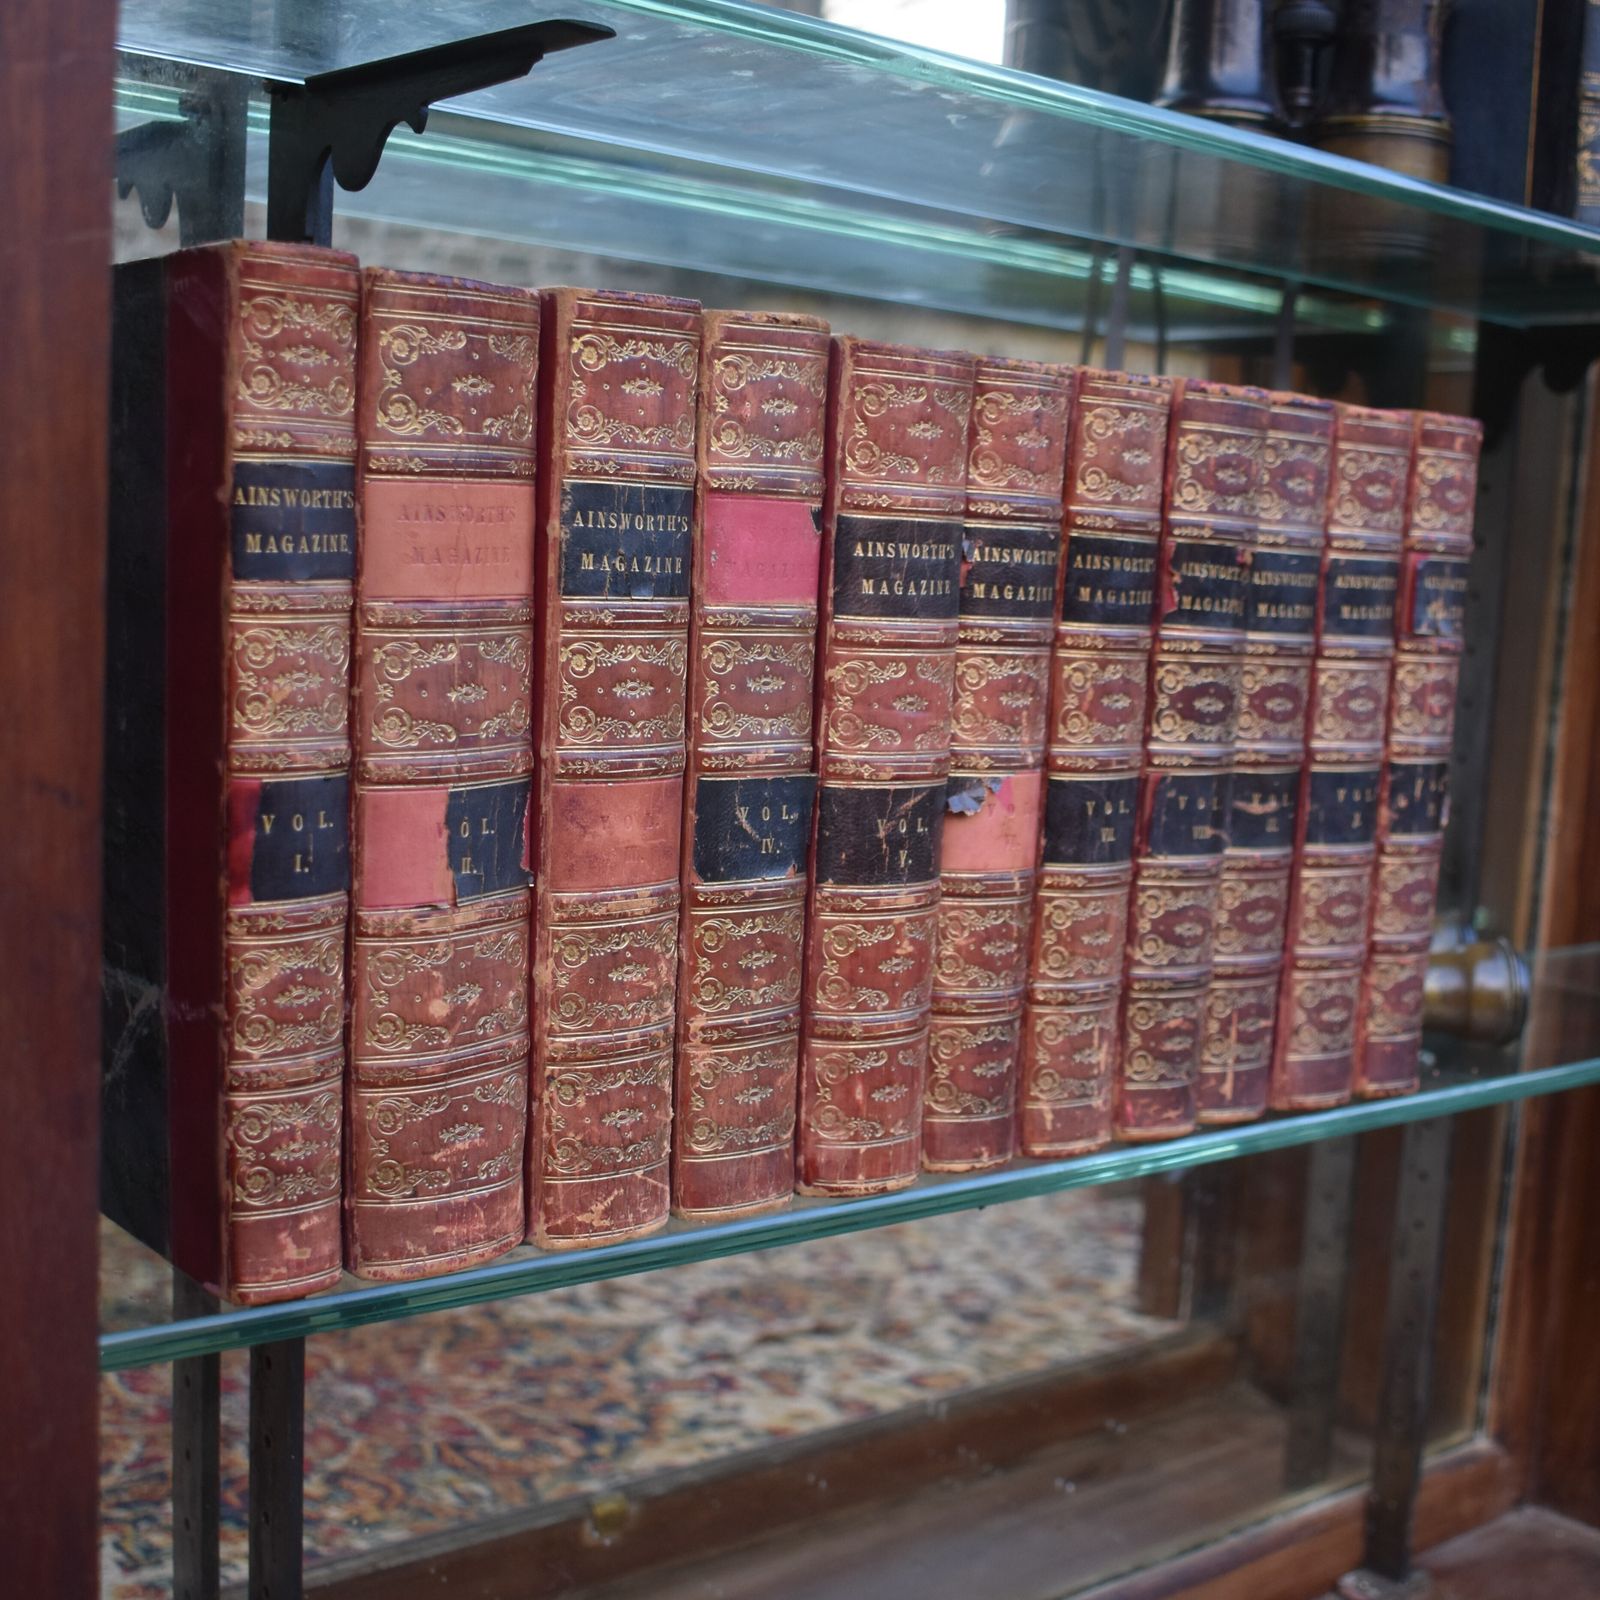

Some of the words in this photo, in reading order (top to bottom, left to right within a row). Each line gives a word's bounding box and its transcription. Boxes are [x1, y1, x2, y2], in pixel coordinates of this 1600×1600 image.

[234, 486, 354, 508] AINSWORTH'S
[573, 510, 688, 532] AINSWORTH'S
[853, 541, 955, 559] AINSWORTH'S
[581, 552, 682, 574] MAGAZINE
[862, 579, 951, 596] MAGAZINE
[262, 810, 334, 834] VOL.
[740, 804, 794, 821] VOL.
[760, 837, 780, 854] IV.
[294, 854, 309, 873] I.
